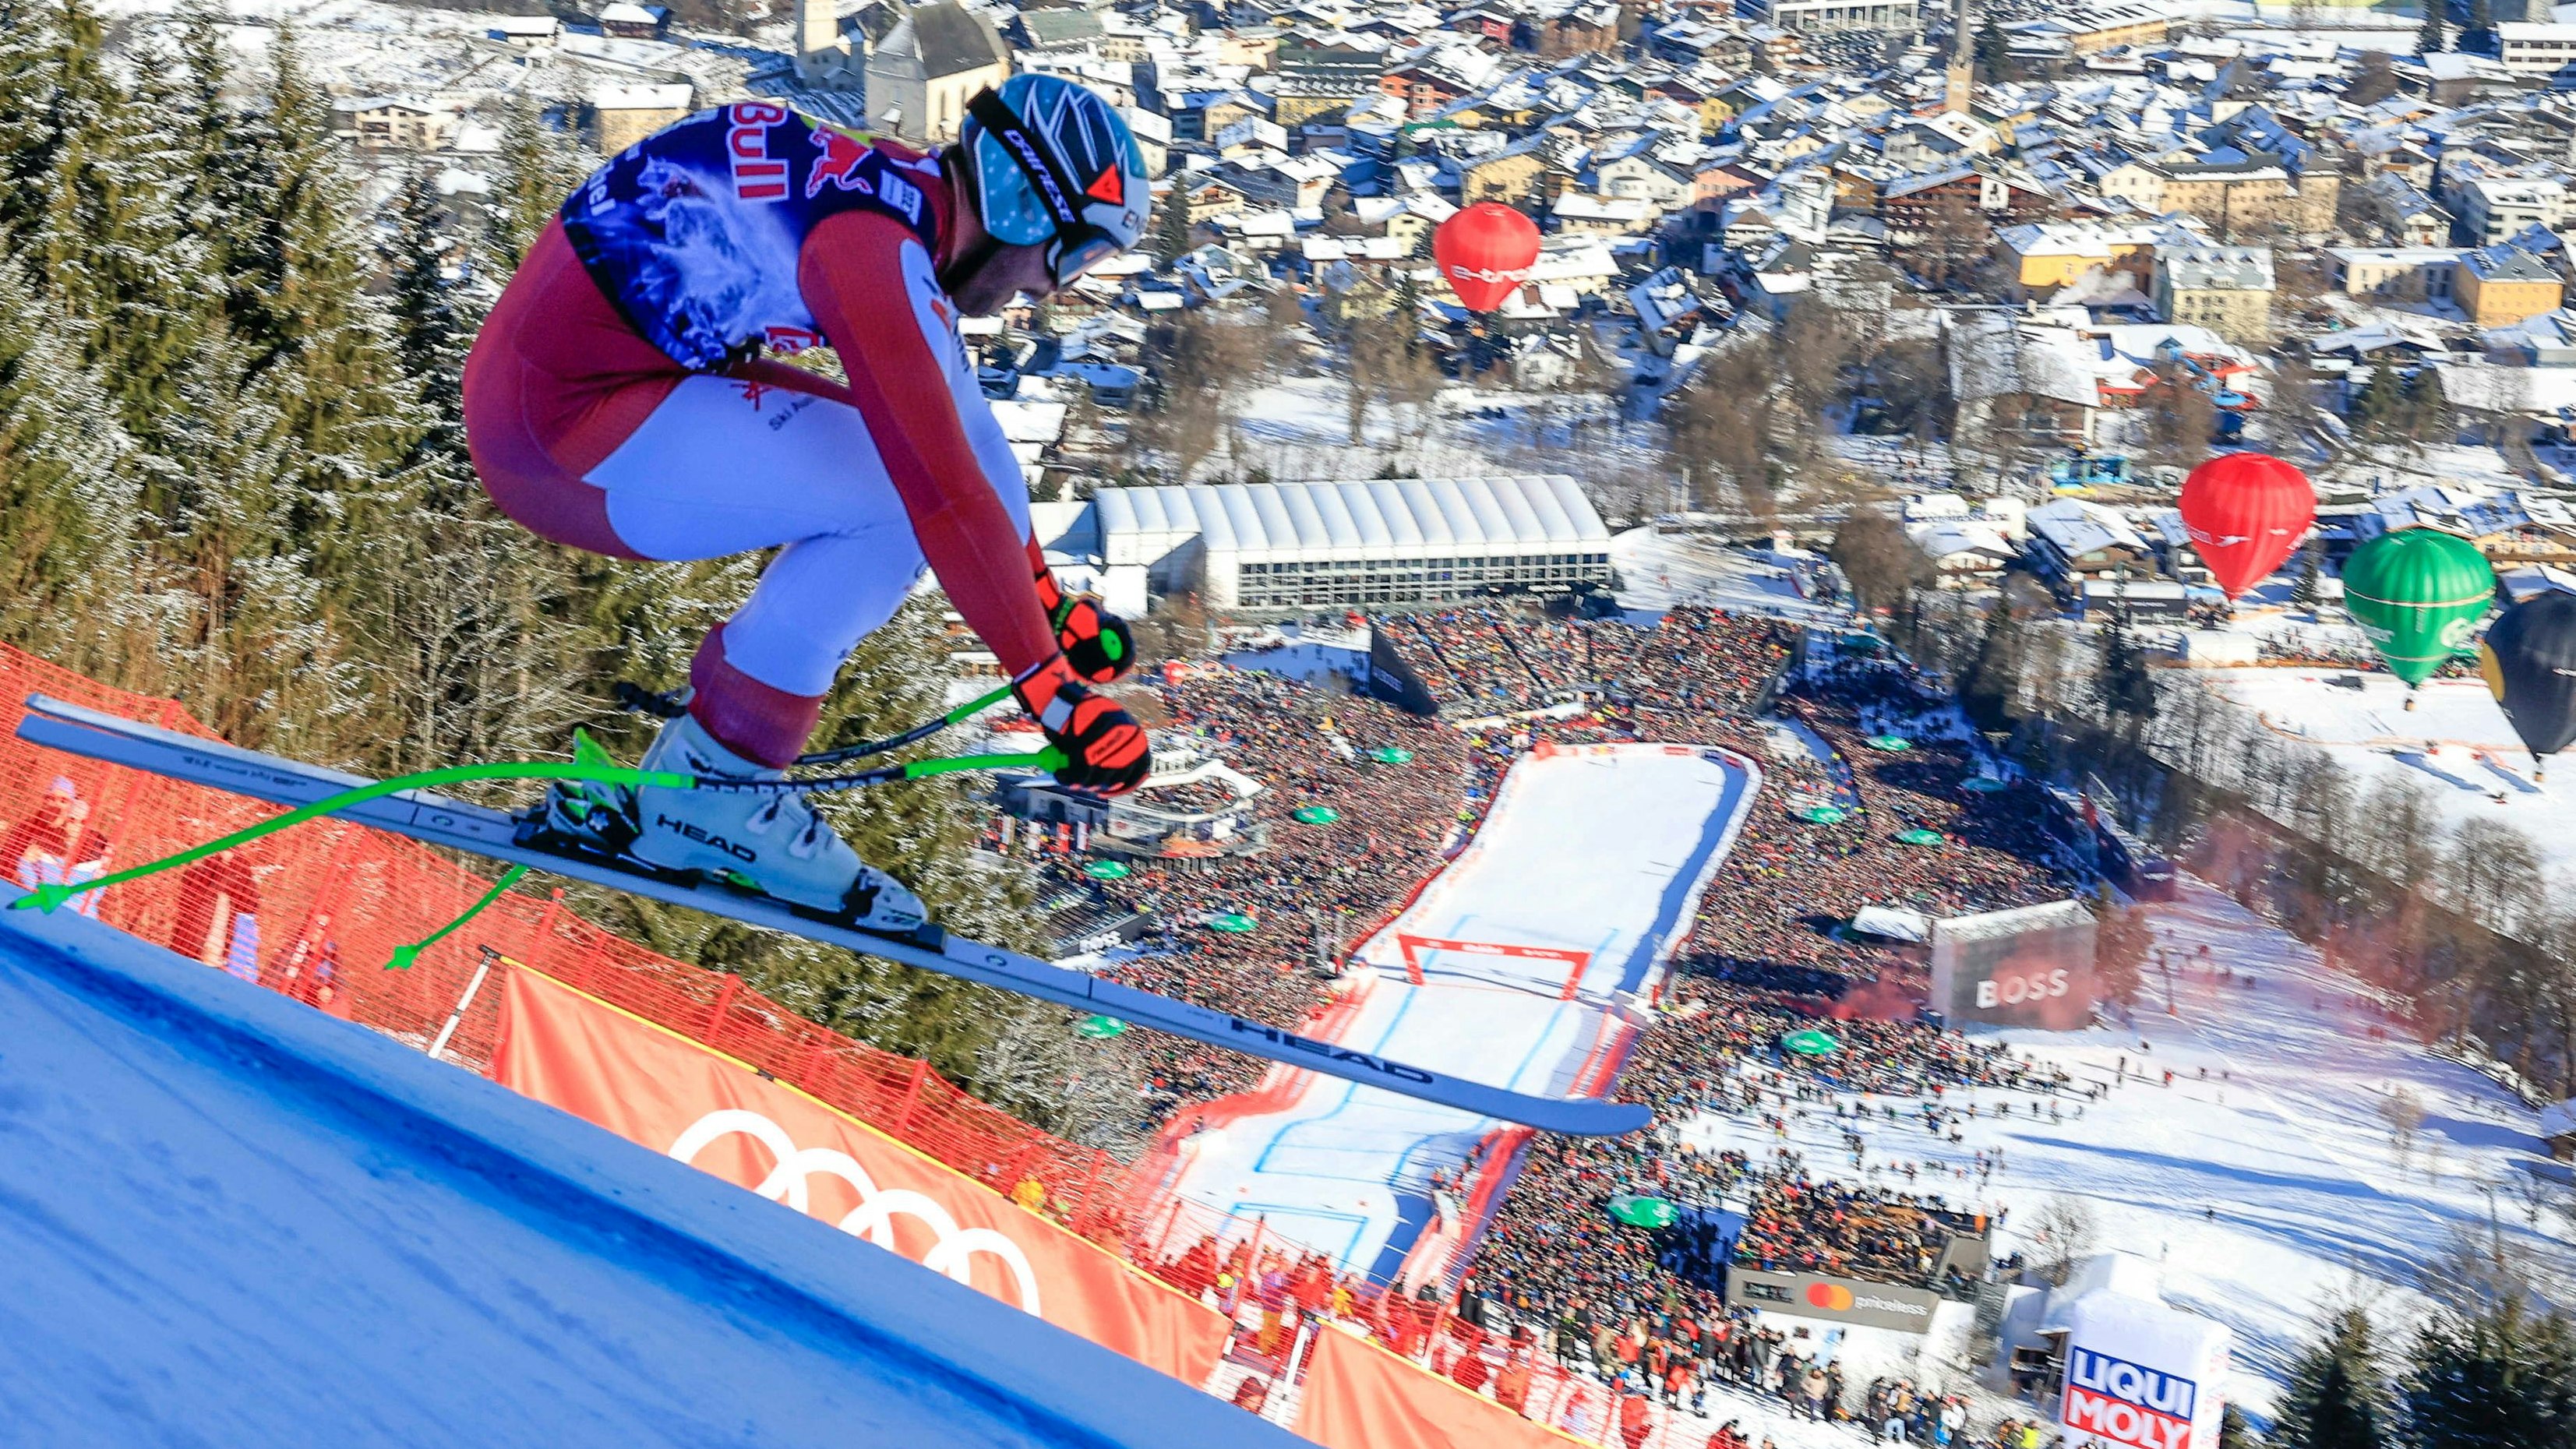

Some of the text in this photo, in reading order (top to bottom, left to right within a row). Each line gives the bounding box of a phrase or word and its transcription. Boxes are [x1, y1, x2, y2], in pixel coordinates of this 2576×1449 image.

[728, 100, 788, 200] Bull
[657, 814, 757, 863] HEAD
[1976, 968, 2070, 1010] BOSS
[1231, 1017, 1434, 1084] HEAD
[1854, 1294, 1928, 1317] priceless
[2072, 1349, 2193, 1419] LIQUI
[2067, 1388, 2191, 1449] MOLY
